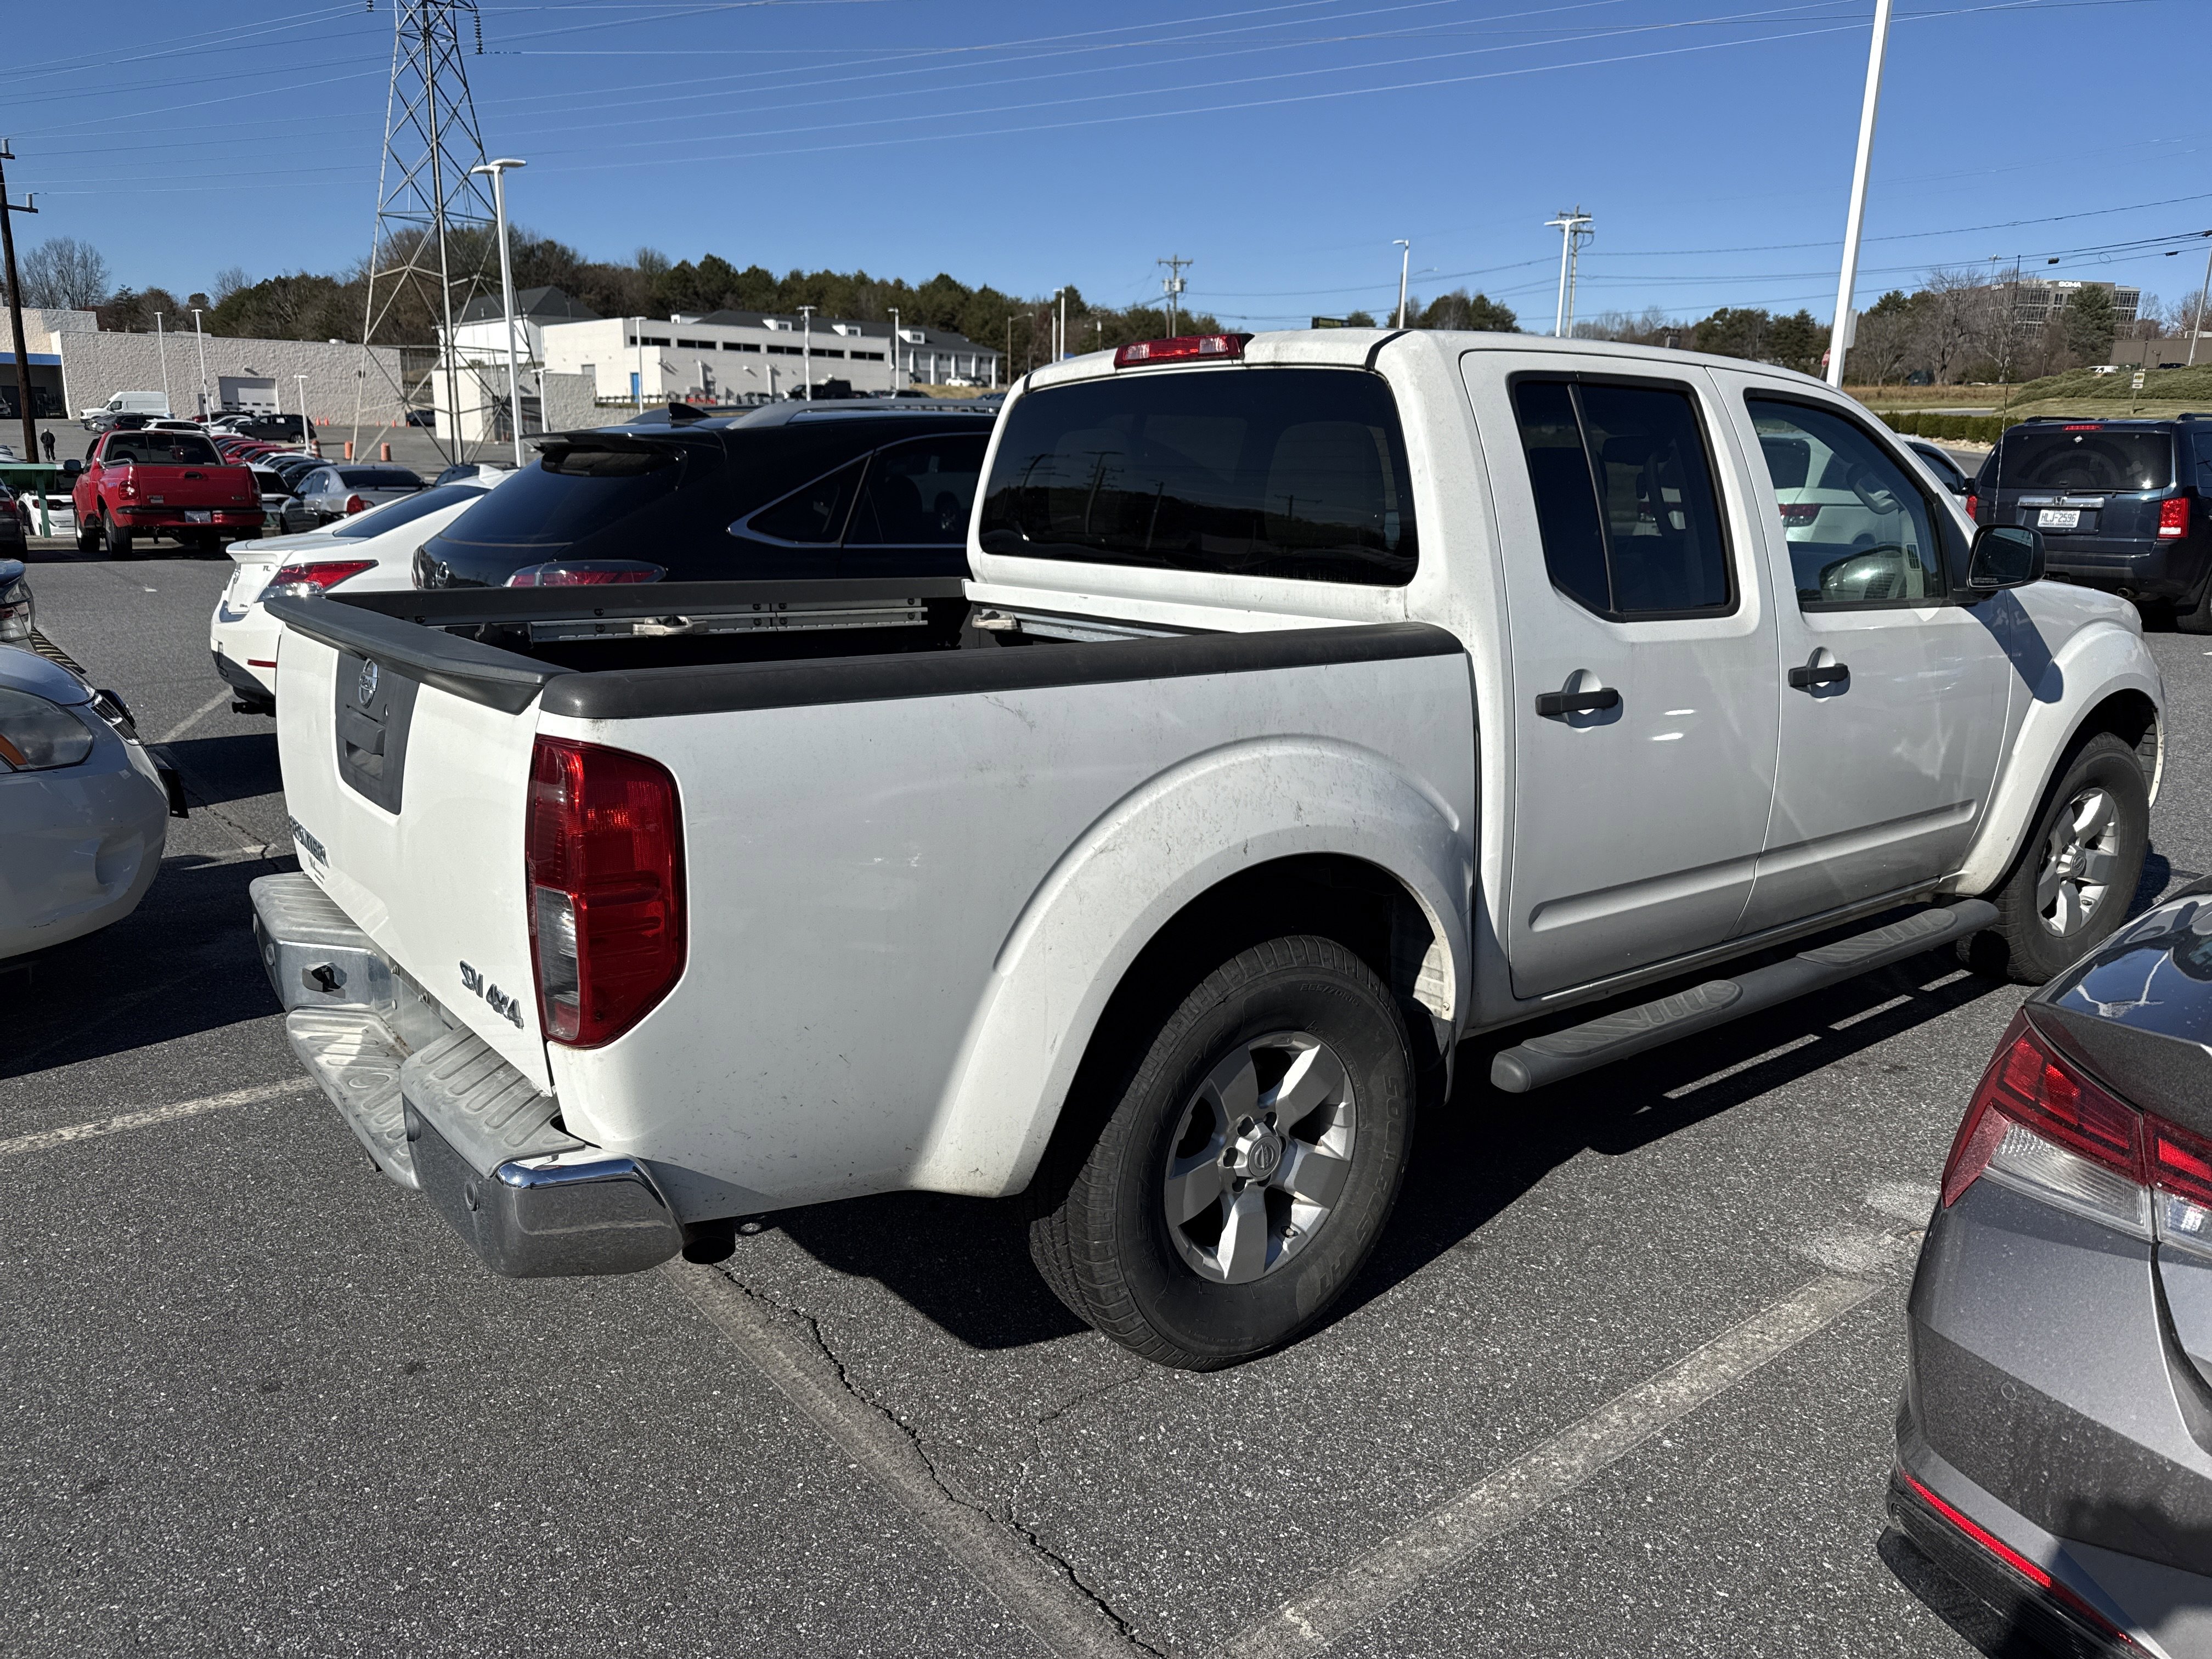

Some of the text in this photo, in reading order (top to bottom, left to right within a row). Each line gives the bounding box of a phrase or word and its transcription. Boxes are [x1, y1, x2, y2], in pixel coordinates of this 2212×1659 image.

[289, 815, 329, 869] FRONTIER
[460, 960, 483, 998] SV
[1134, 1024, 1226, 1240] STARFIRE
